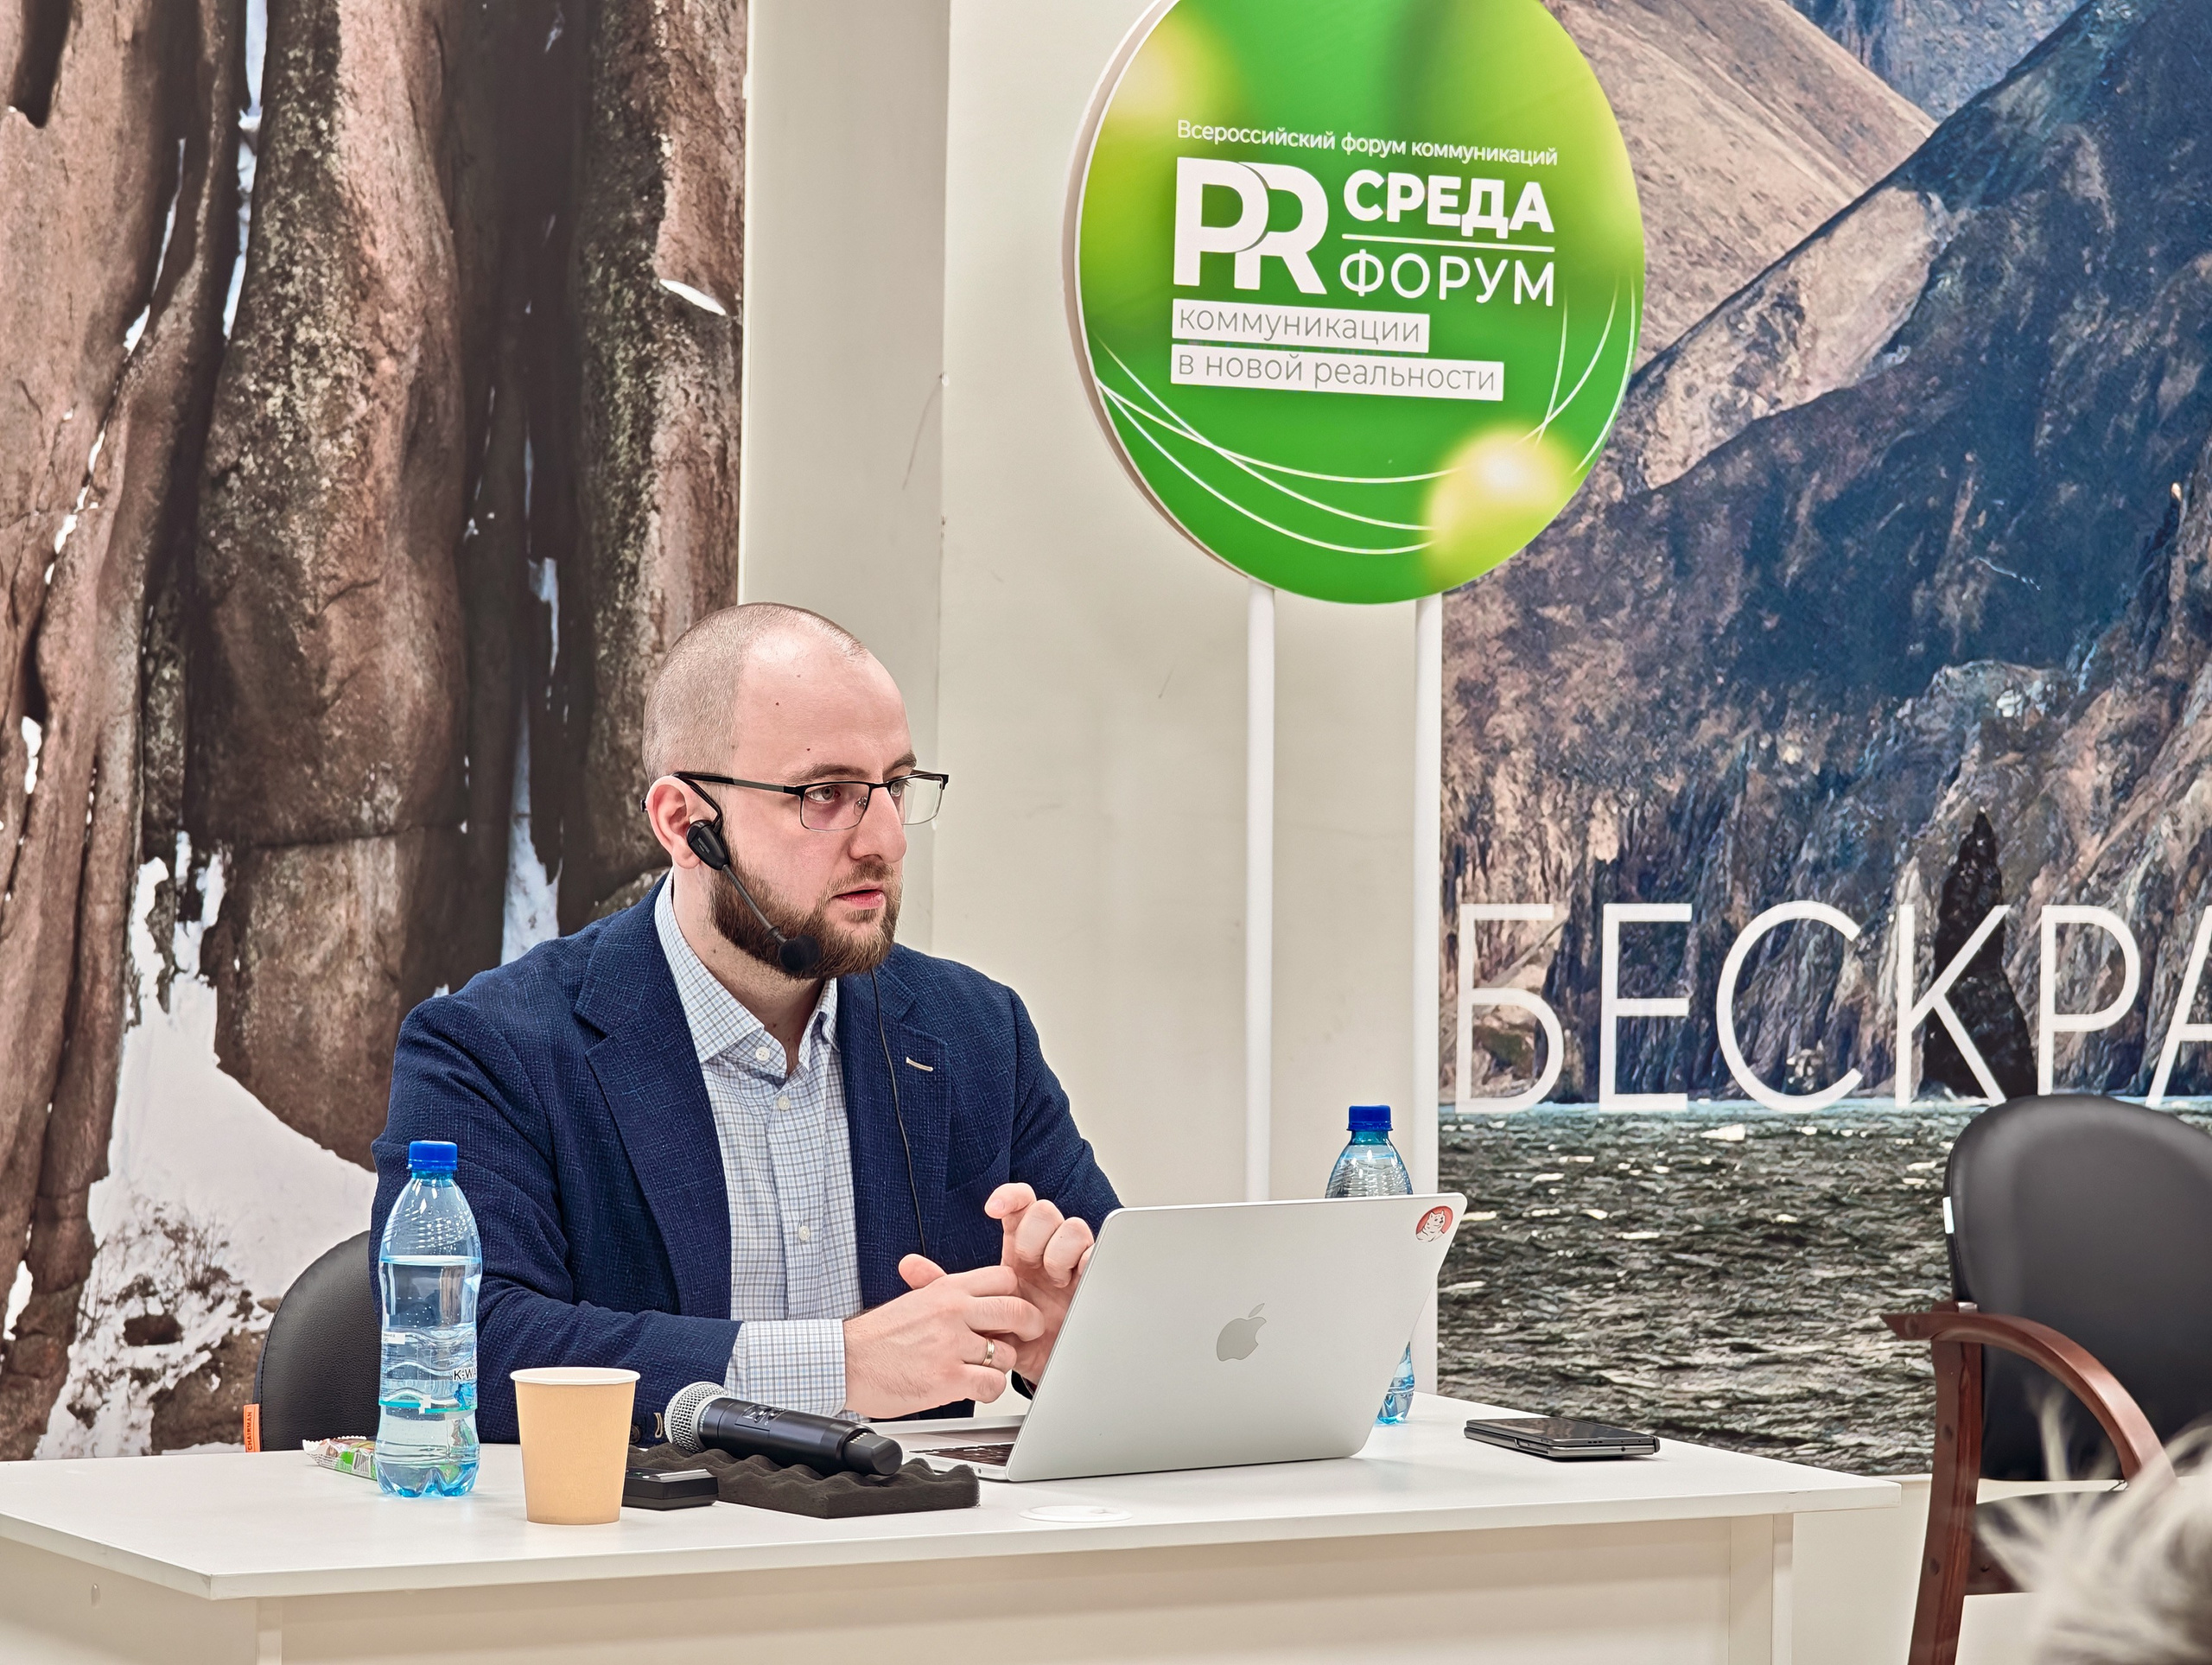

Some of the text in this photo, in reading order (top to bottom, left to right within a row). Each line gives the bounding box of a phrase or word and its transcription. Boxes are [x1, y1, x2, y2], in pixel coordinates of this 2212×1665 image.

[1177, 119, 1558, 166] Всероссийский форум коммуникаций
[1173, 156, 1329, 295] PR
[1343, 169, 1555, 238] СРЕДА
[1339, 249, 1554, 307] ФОРУМ
[1179, 308, 1420, 345] коммуникации
[1179, 353, 1495, 390] в новой реальности
